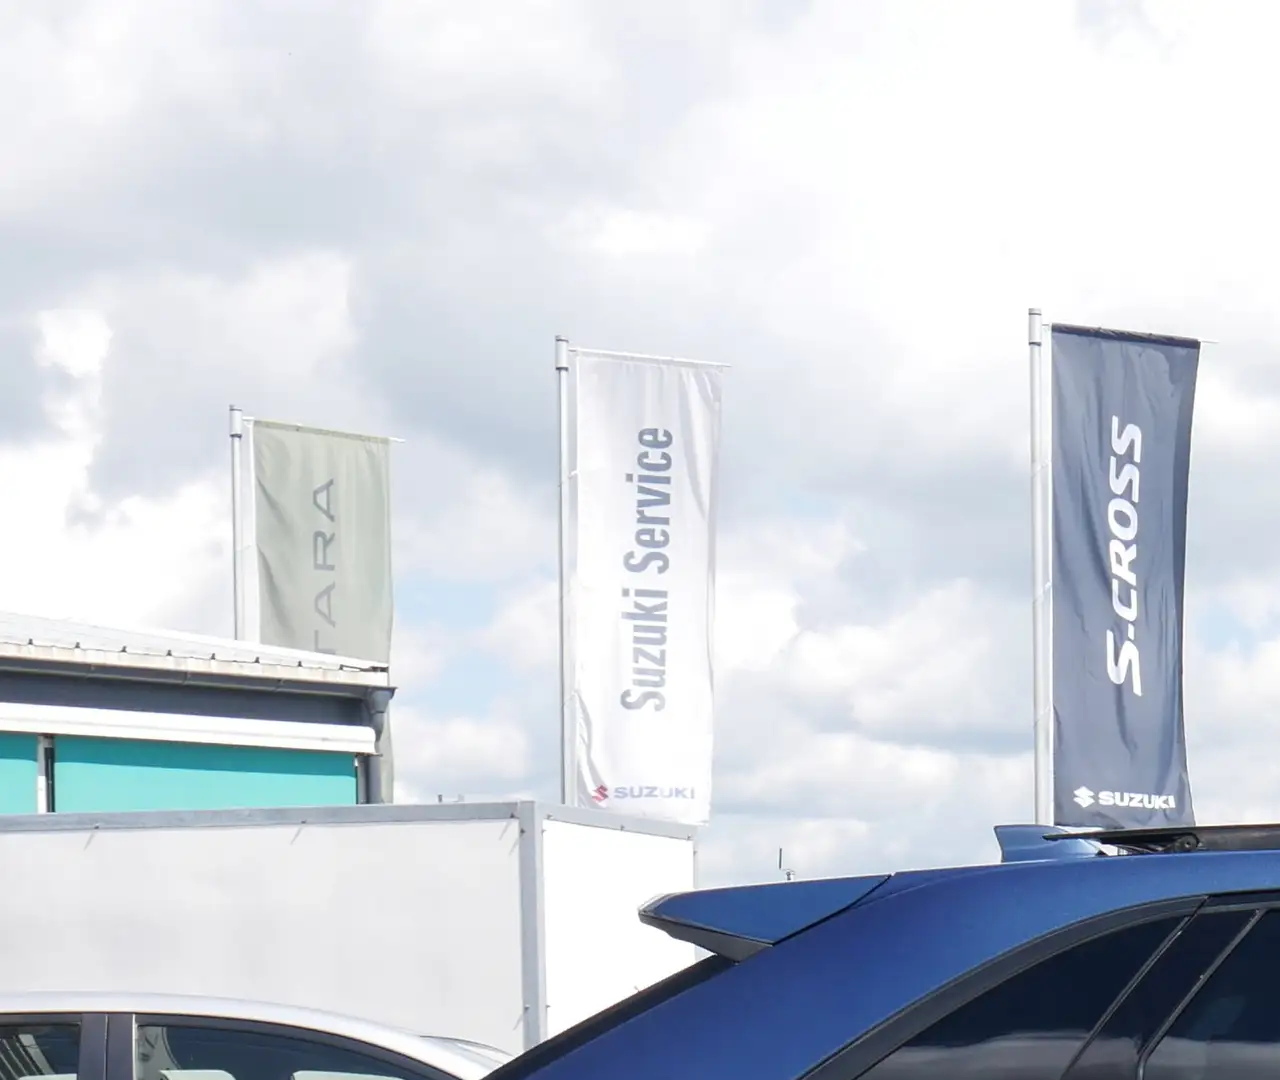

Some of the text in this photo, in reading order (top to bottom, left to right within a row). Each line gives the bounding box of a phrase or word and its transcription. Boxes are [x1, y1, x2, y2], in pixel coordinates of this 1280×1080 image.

[619, 427, 674, 712] Suzuki Service
[612, 785, 696, 800] SUZUKI
[1097, 790, 1177, 809] SUZUKI
